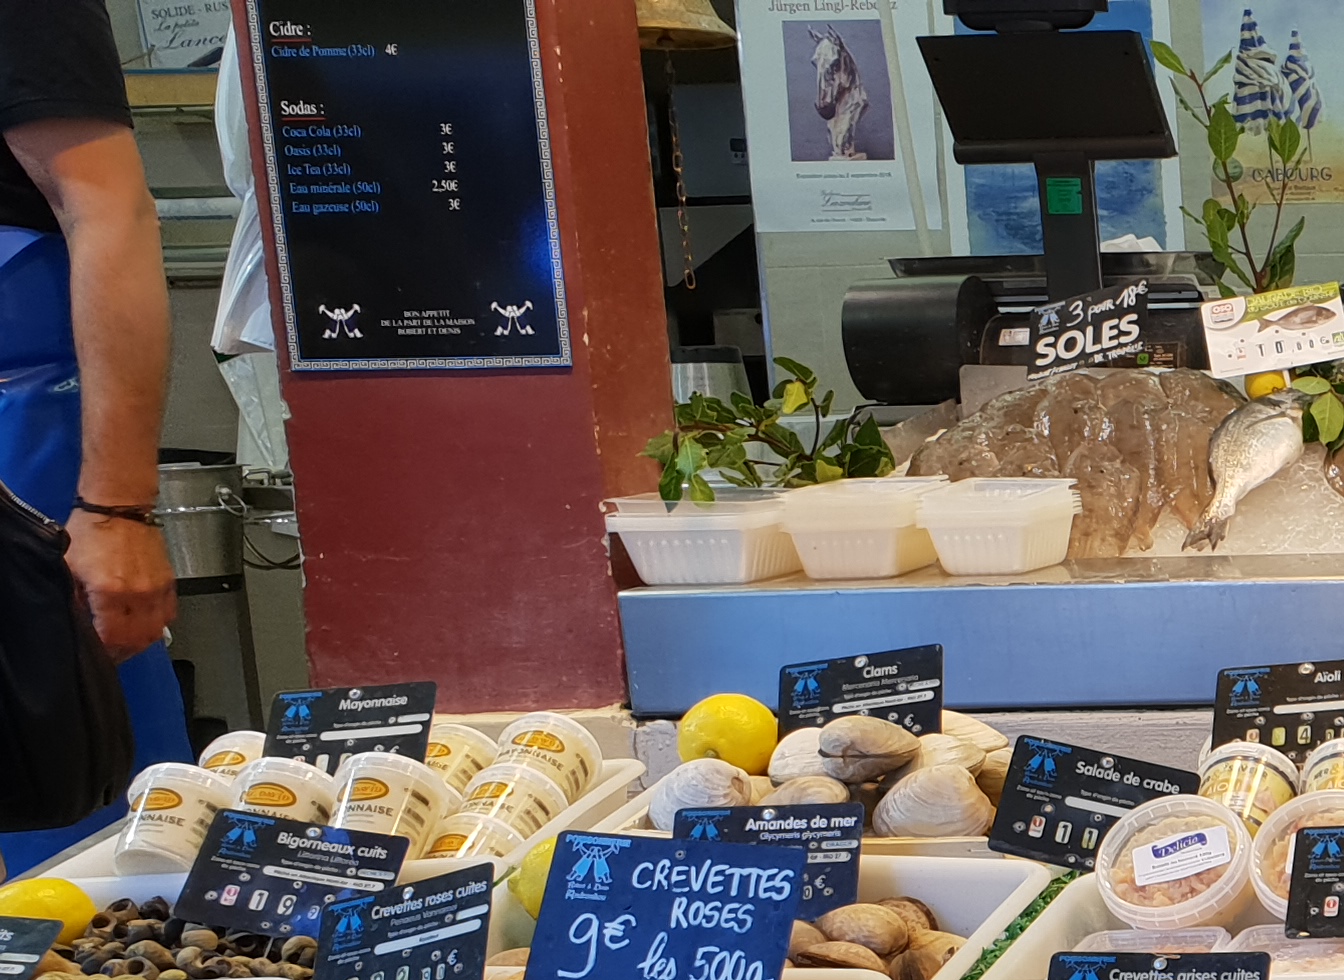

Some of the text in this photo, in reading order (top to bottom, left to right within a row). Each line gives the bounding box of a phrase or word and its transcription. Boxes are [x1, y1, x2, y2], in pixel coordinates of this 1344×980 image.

[151, 2, 229, 19] SOLIDE RUS
[270, 21, 303, 36] Cidre
[272, 44, 398, 57] Cidre de Pomme (33cl) 4€
[281, 101, 317, 115] Sodas
[282, 124, 452, 137] Coca Cola (33cl) 3€
[1252, 167, 1332, 182] CABOURG
[1066, 280, 1148, 326] 3 18€
[1212, 303, 1233, 314] OSO
[1035, 314, 1139, 366] SOLES
[863, 665, 898, 678] Clams
[339, 696, 408, 711] Mayonnaise
[1076, 762, 1179, 794] Salade de crabe
[745, 816, 857, 831] Amandes de mer
[277, 832, 388, 859] Bigorneaux cuits
[632, 859, 795, 900] CREVETTES
[371, 881, 487, 920] Crevettes roses cuites
[670, 897, 755, 934] ROSES
[557, 913, 636, 980] 9€
[637, 932, 678, 980] les
